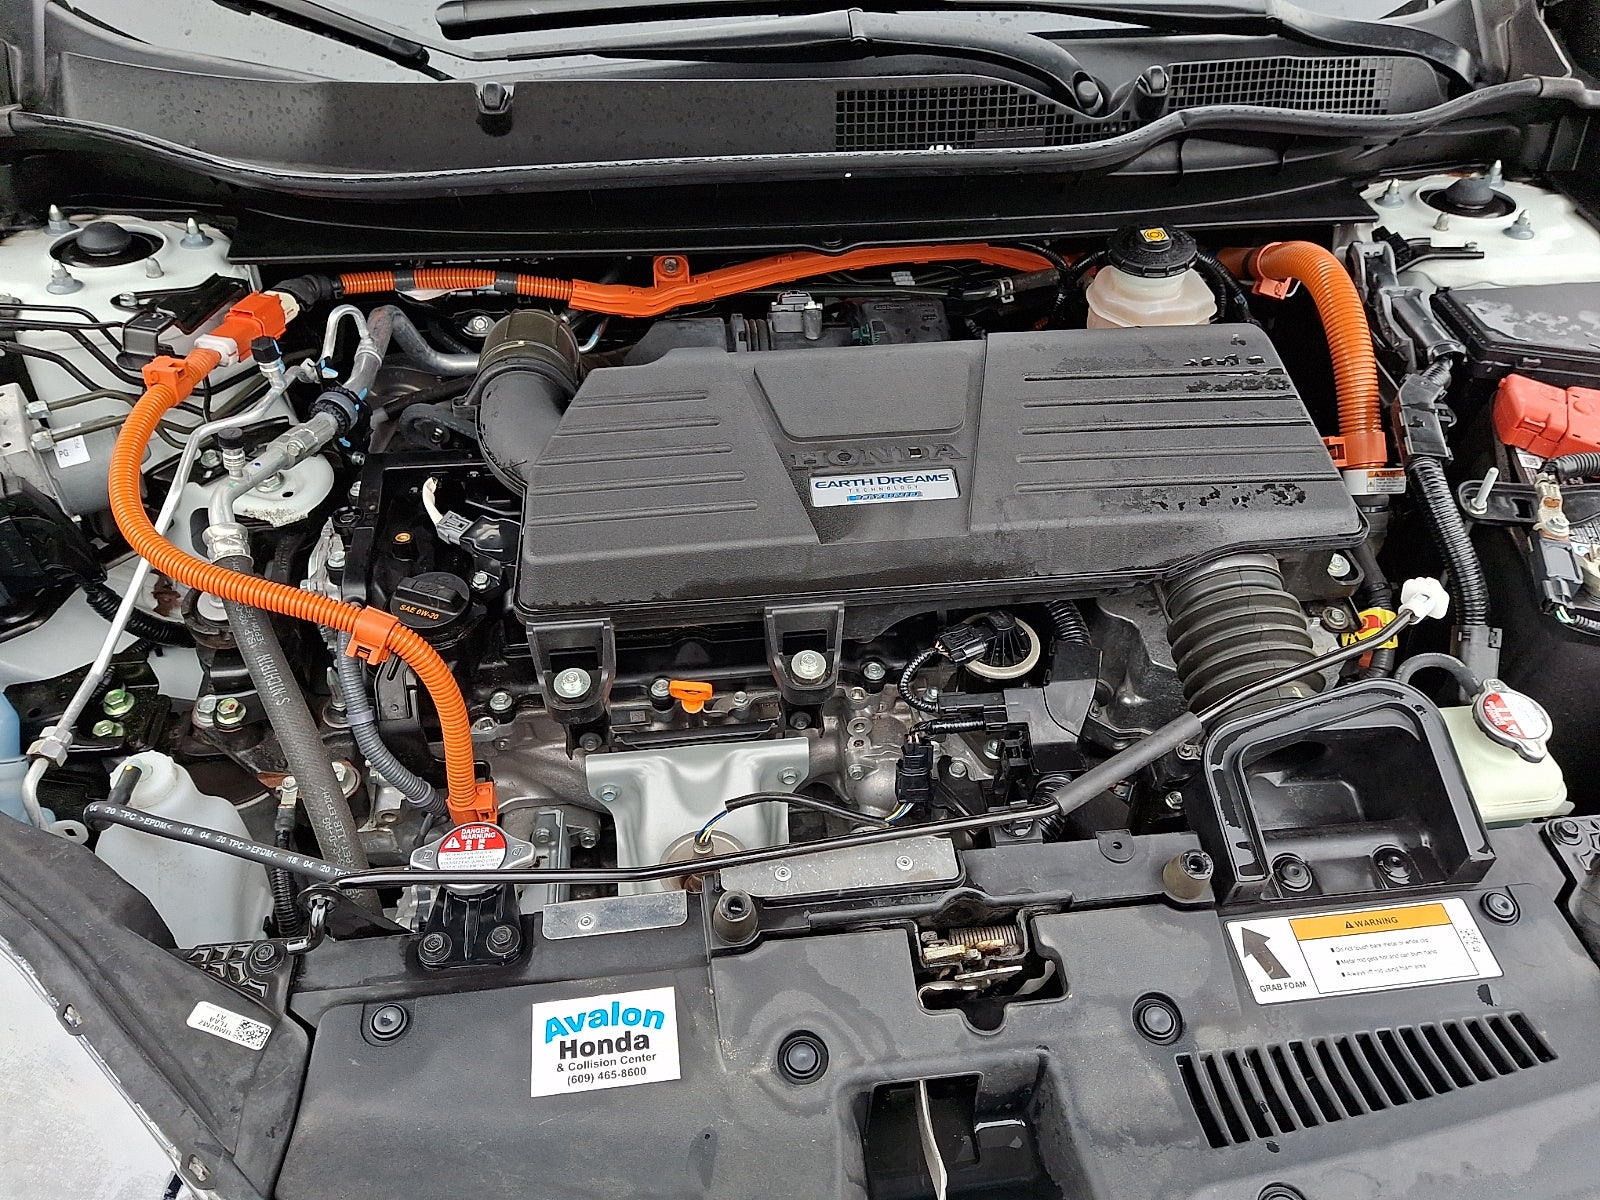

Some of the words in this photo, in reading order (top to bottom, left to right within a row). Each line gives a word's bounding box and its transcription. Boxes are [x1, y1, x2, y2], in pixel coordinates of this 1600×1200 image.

[787, 443, 967, 470] HONDA
[814, 478, 874, 489] EARTH
[848, 485, 919, 494] TECHNOLOGY
[399, 604, 416, 614] SAE
[416, 609, 440, 620] 0W-20
[120, 809, 138, 820] TPC
[230, 838, 244, 850] TPC
[462, 826, 490, 834] DANGER
[1354, 916, 1399, 928] WARNING
[1260, 983, 1283, 992] GRAB
[1284, 980, 1307, 989] FOAM
[545, 1001, 665, 1044] Avalon
[560, 1030, 650, 1060] Honda
[556, 1063, 564, 1072] &
[568, 1059, 617, 1072] Collision
[620, 1053, 657, 1065] Center
[567, 1073, 594, 1086] (609)
[598, 1066, 647, 1080] 465-8600
